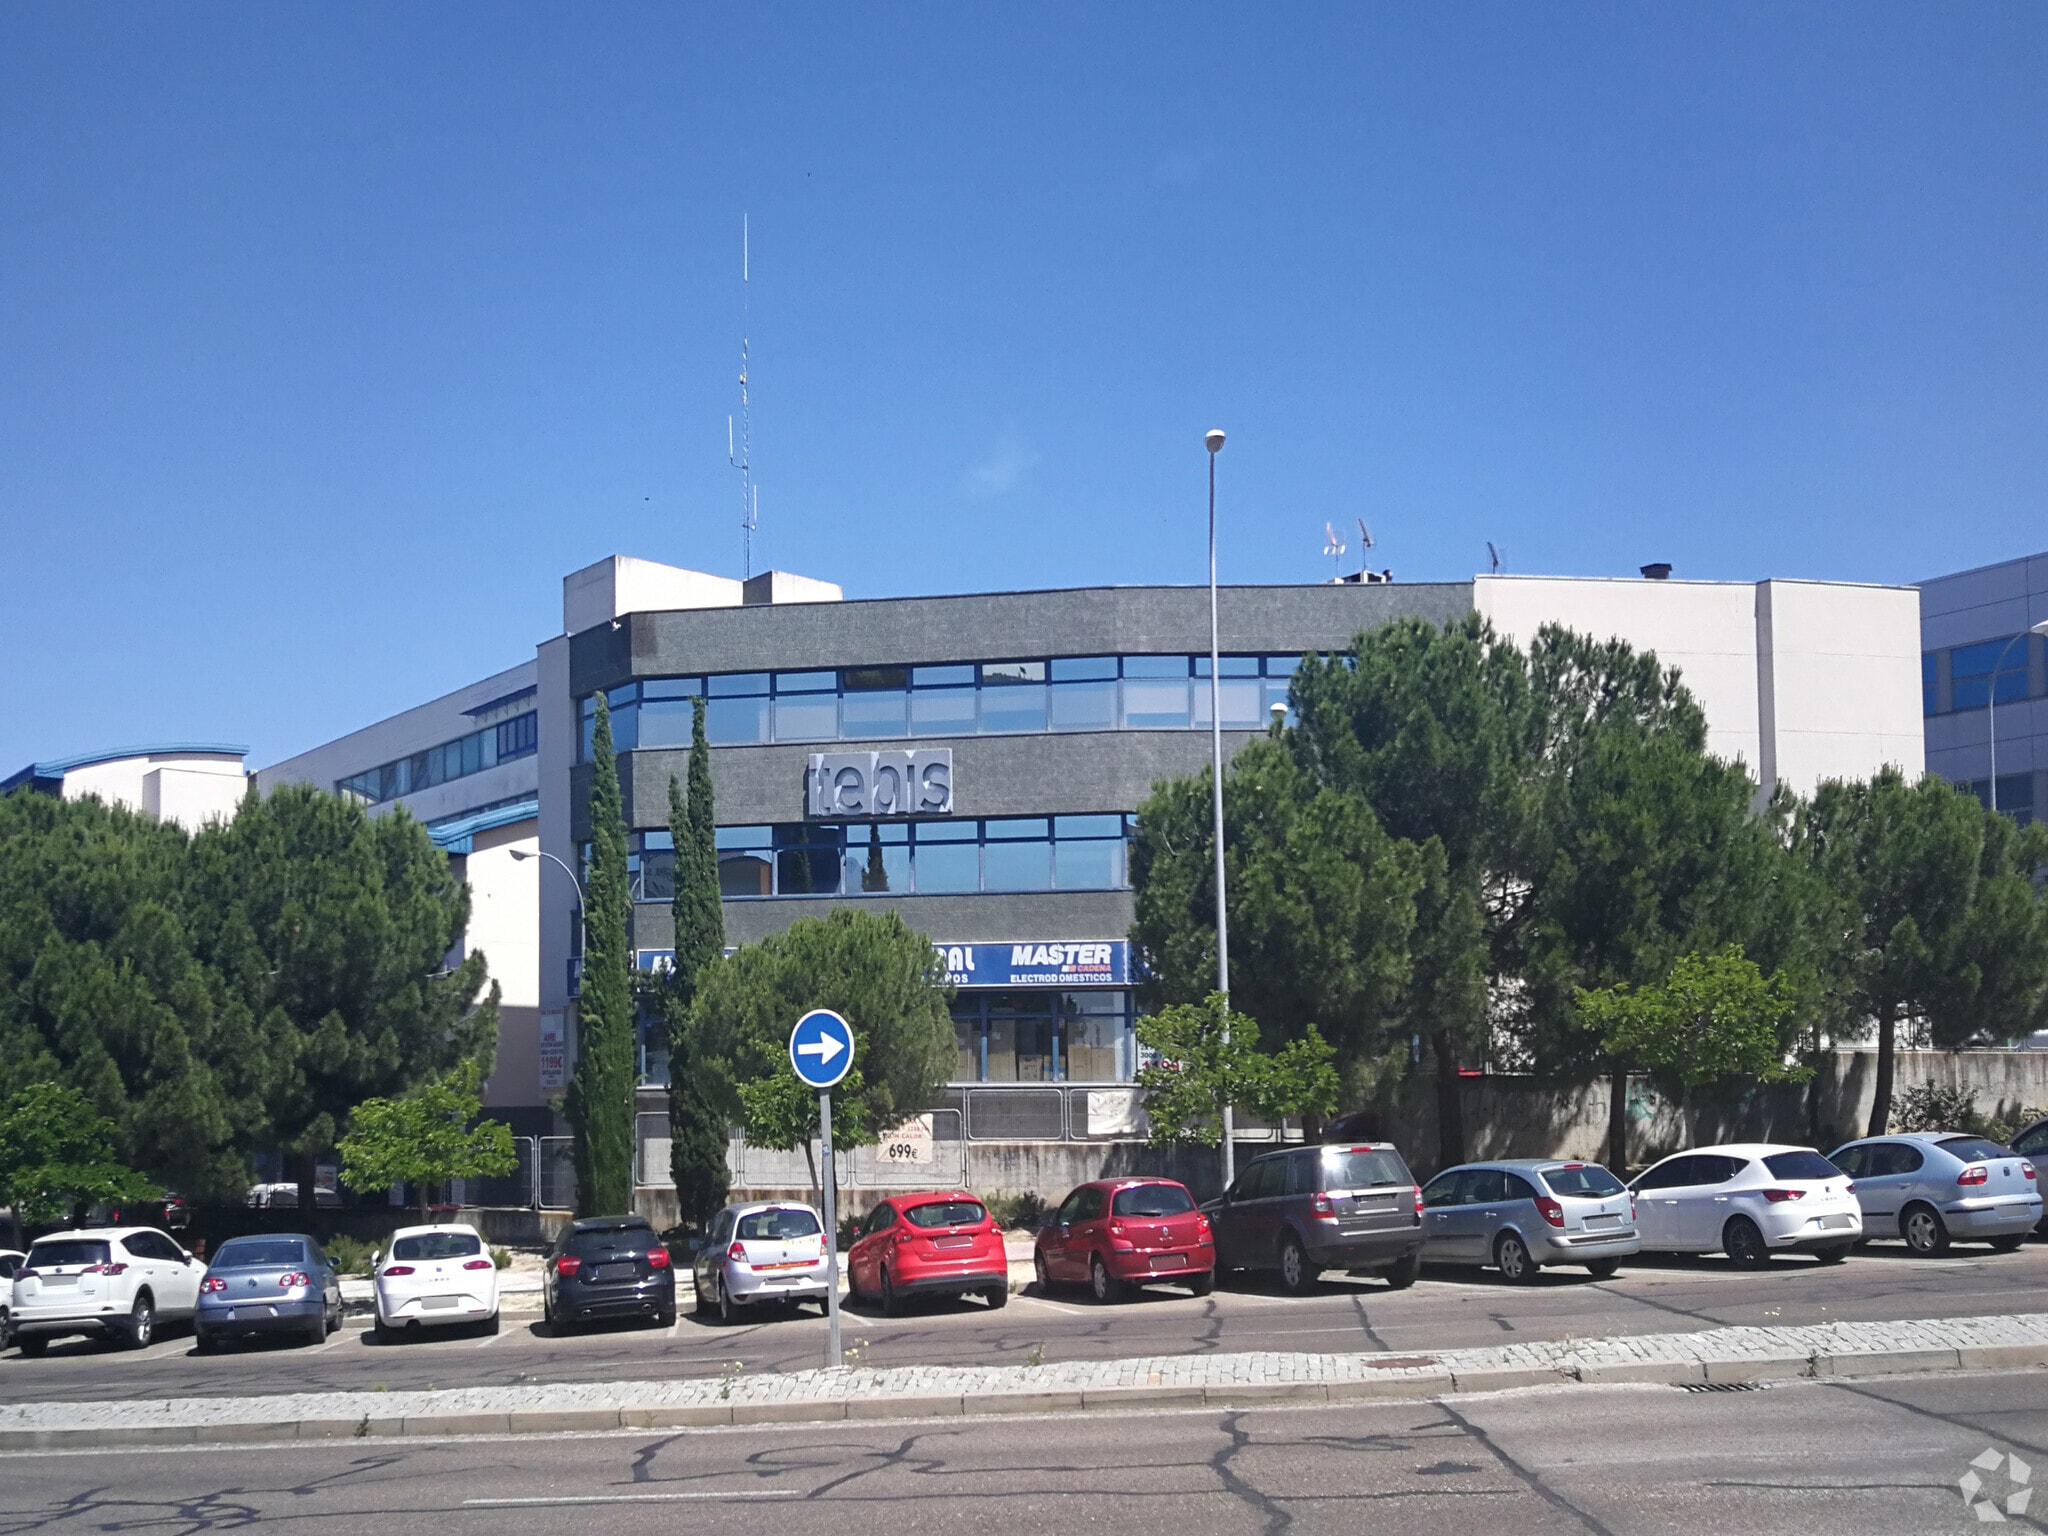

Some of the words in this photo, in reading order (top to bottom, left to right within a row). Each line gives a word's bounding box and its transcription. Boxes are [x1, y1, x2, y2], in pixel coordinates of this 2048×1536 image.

[809, 750, 952, 816] tebis
[1010, 943, 1112, 966] MASTER
[1077, 964, 1112, 973] CADENA
[889, 1144, 918, 1159] 699€
